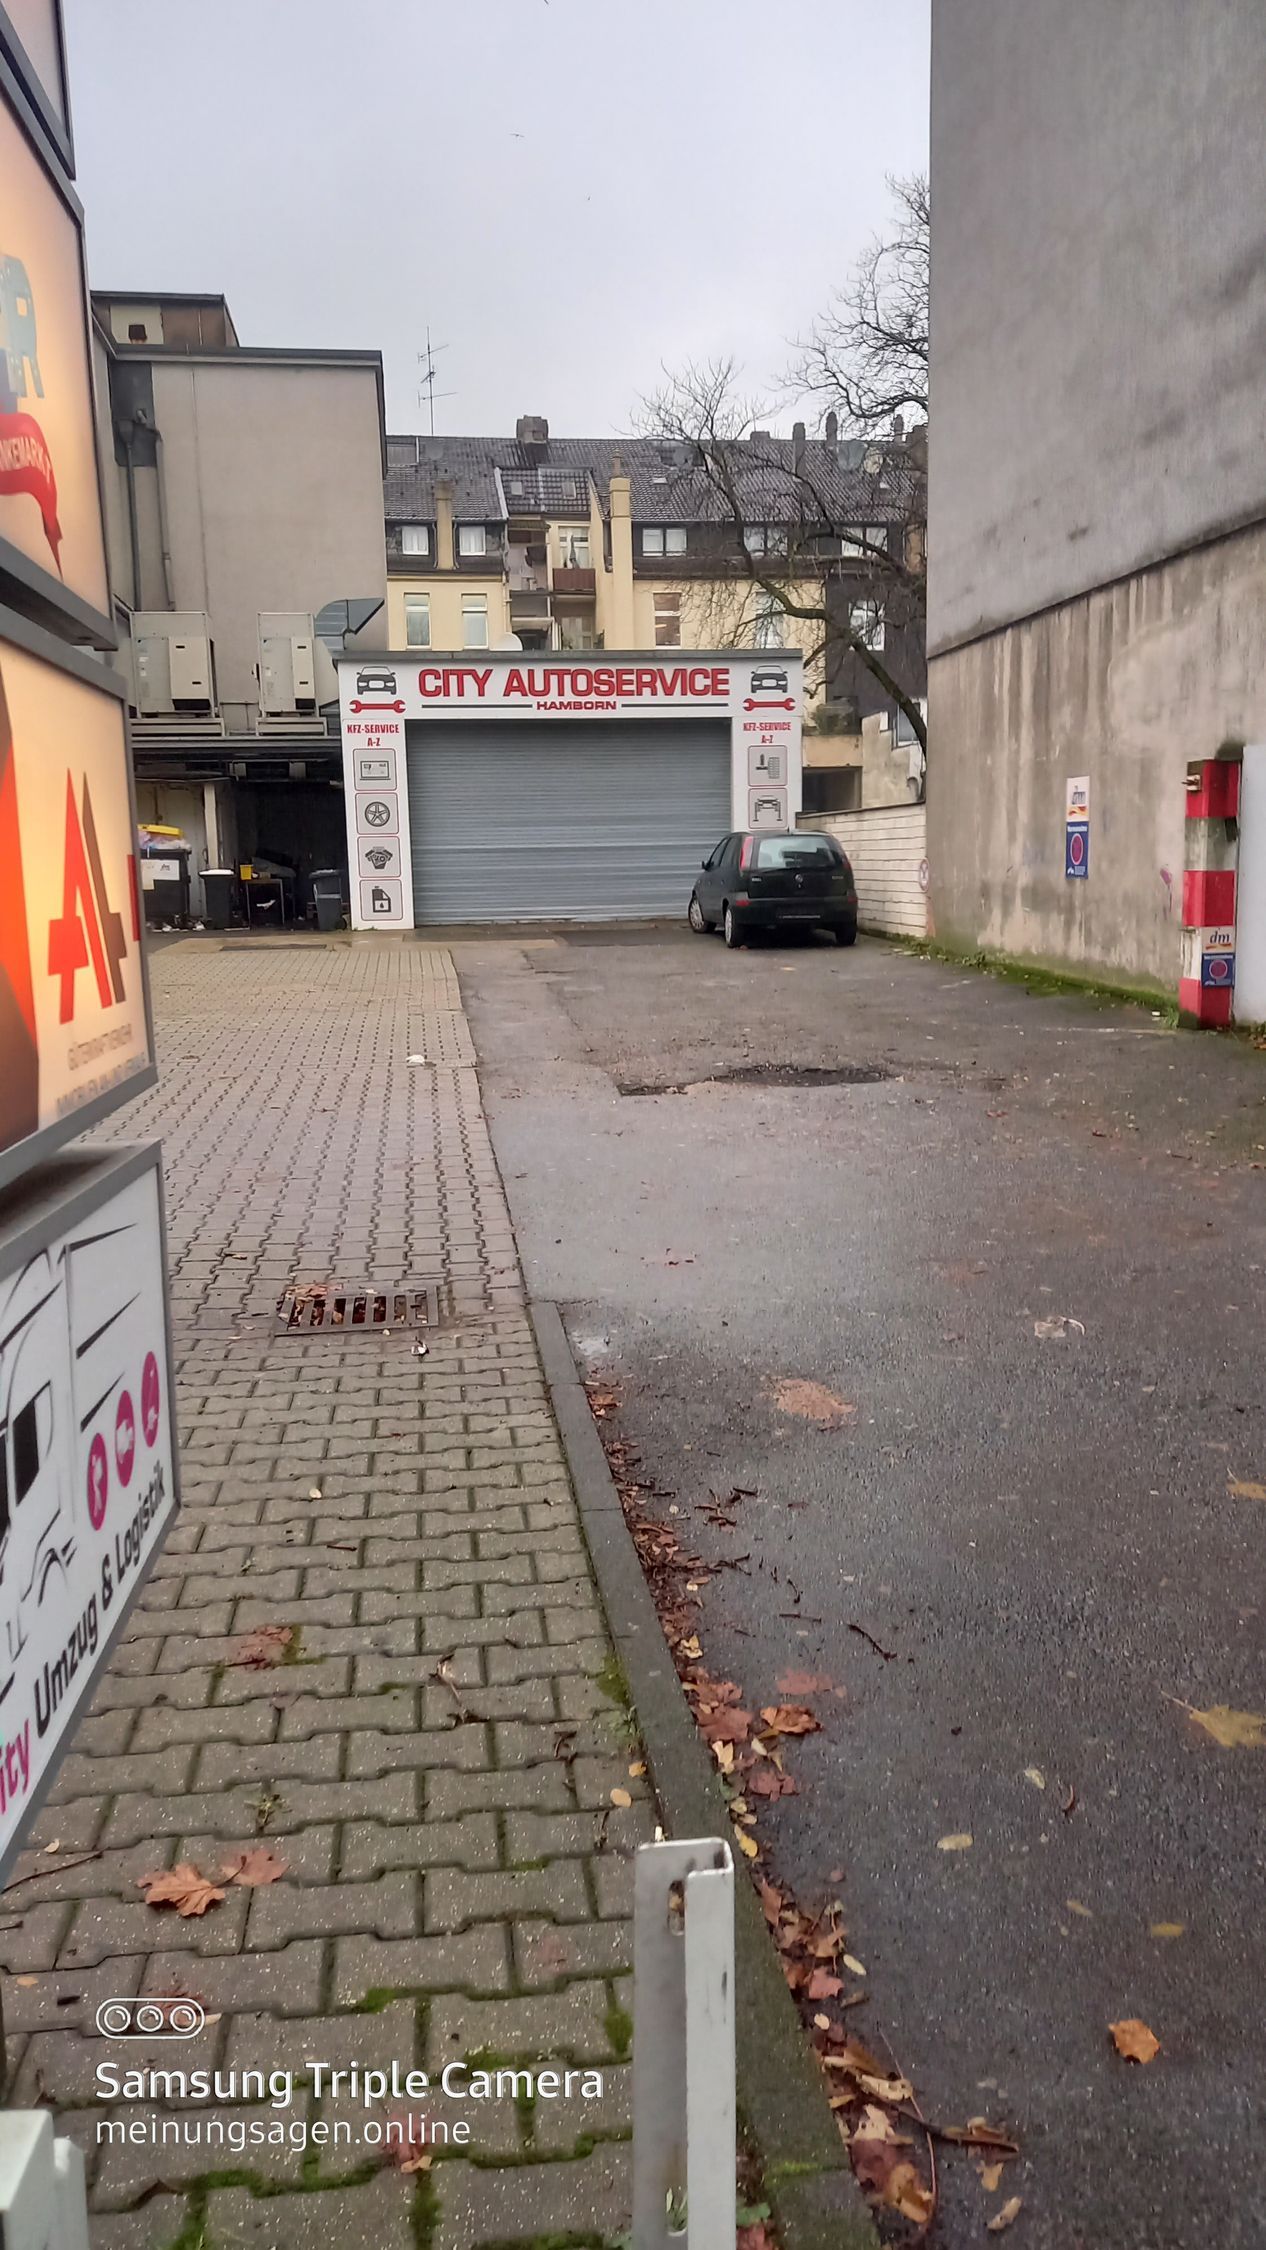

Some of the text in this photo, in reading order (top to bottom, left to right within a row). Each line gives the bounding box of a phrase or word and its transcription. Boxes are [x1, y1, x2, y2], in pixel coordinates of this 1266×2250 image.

[418, 668, 730, 698] CITY AUTOSERVICE
[536, 701, 617, 711] HAMBORN
[347, 724, 400, 734] KFZ-SERVICE
[743, 722, 792, 732] KFZ-SERVICE
[367, 737, 381, 747] A-Z
[1209, 930, 1231, 945] dm
[34, 1592, 98, 1739] Umzug
[102, 1553, 114, 1611] &
[115, 1459, 166, 1584] Logistik
